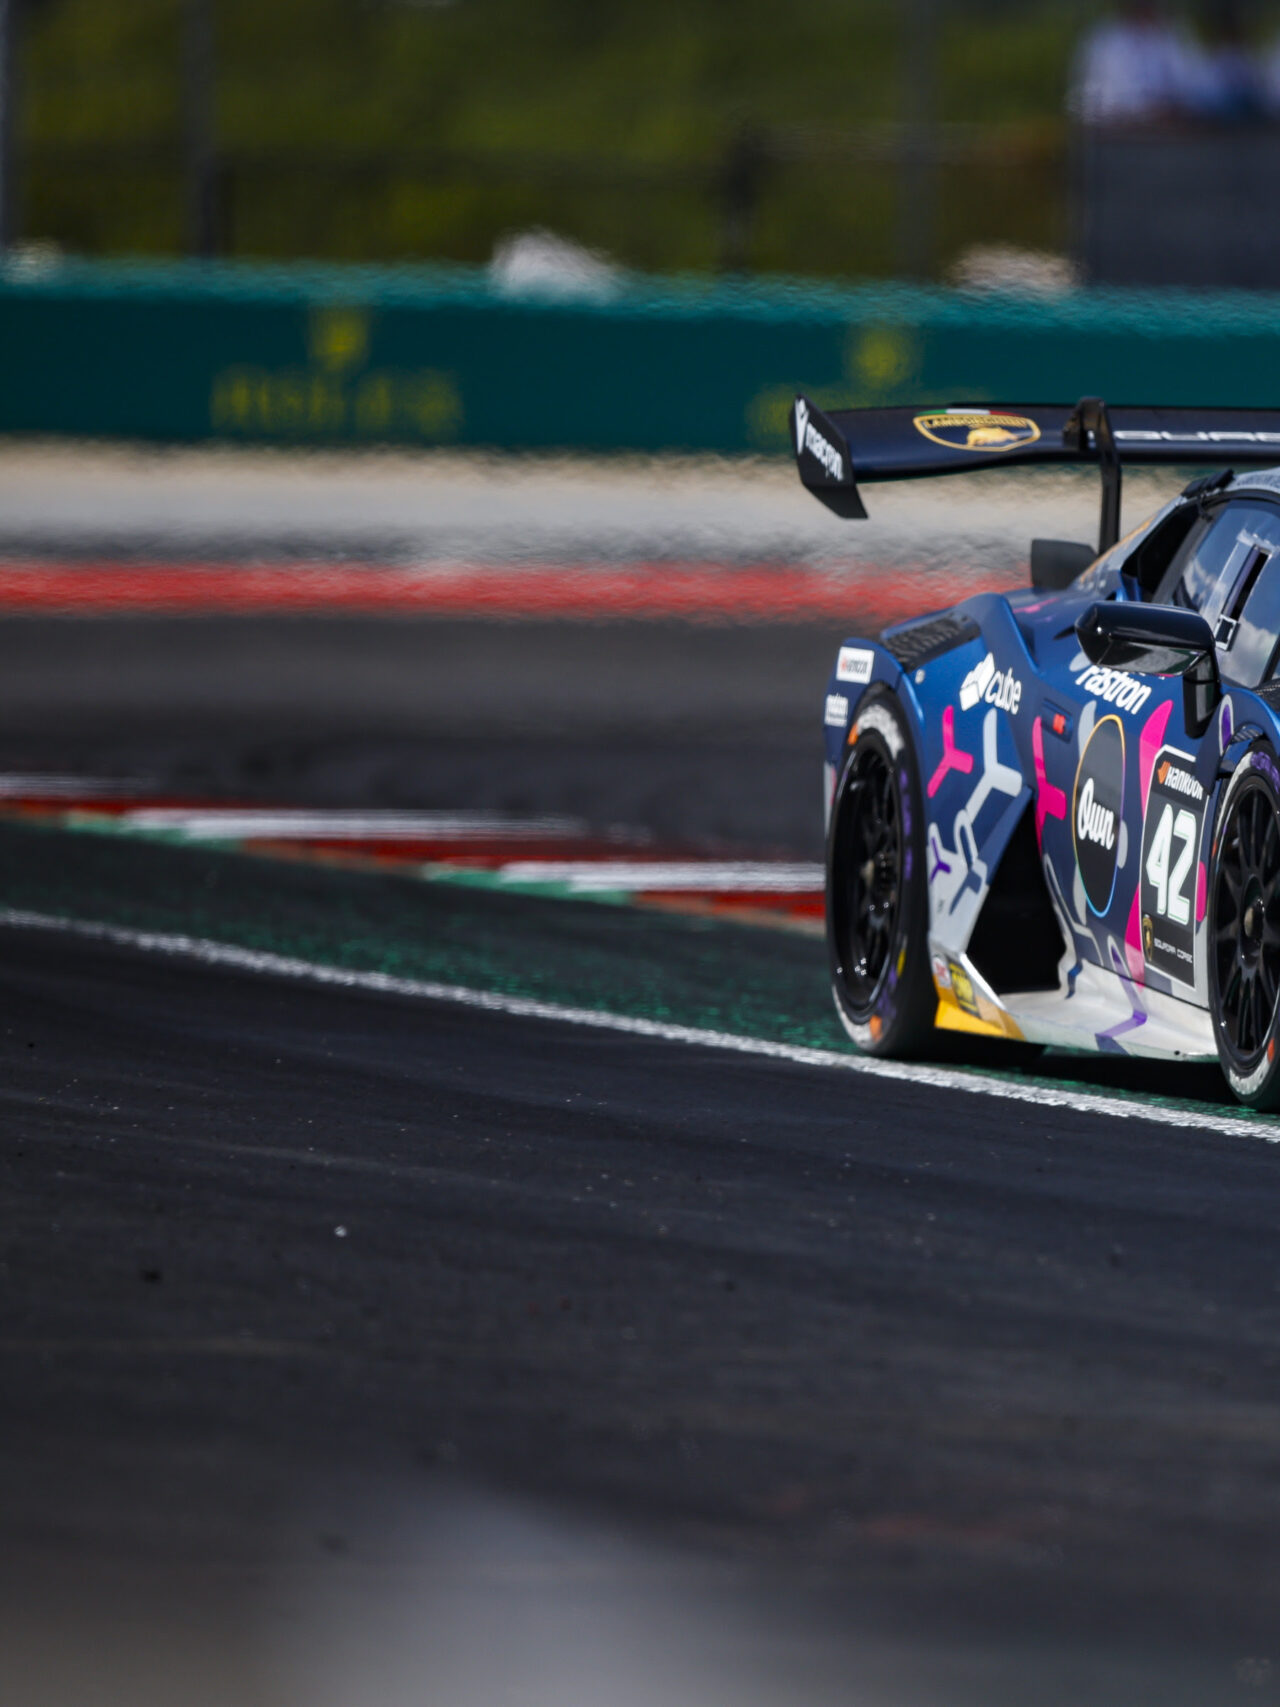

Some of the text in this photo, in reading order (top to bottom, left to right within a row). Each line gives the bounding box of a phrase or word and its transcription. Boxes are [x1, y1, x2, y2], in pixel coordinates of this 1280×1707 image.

[985, 667, 1022, 715] cube
[1077, 777, 1116, 851] Own
[1146, 803, 1197, 926] 42
